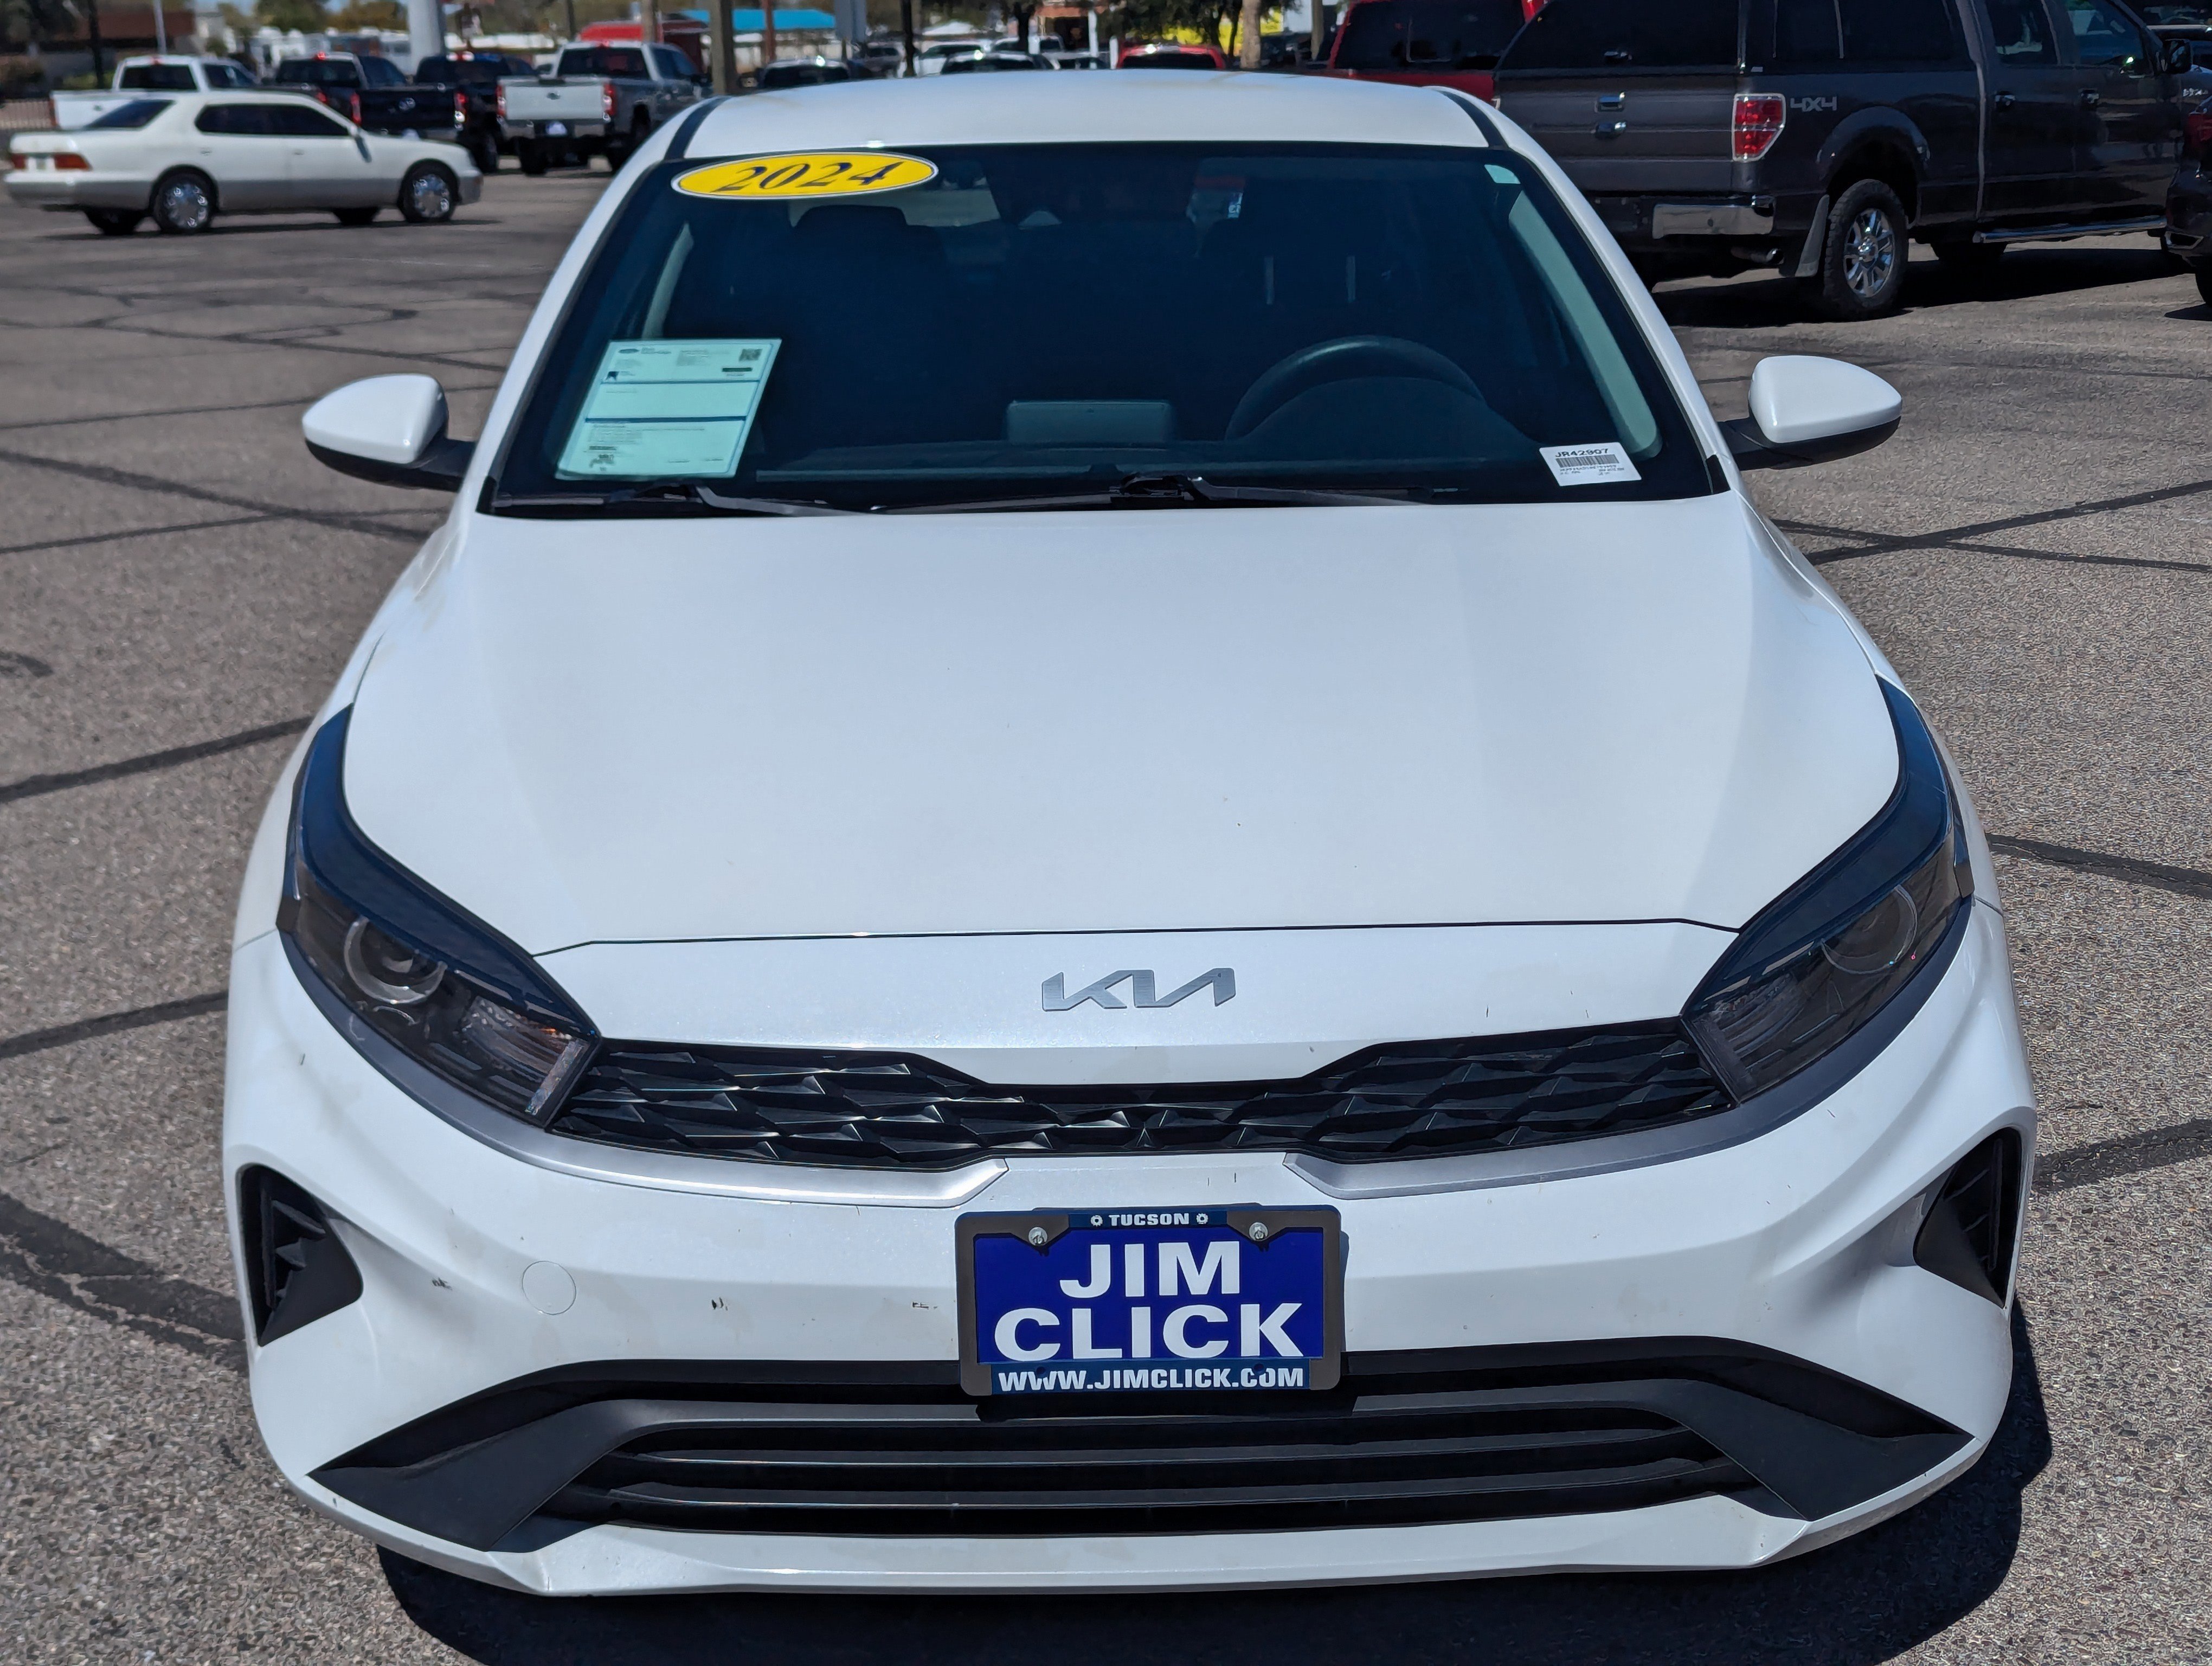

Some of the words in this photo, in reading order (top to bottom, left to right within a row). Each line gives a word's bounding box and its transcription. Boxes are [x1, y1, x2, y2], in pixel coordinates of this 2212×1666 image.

[1790, 97, 1837, 112] 4X4
[710, 161, 905, 194] 2024
[1042, 967, 1236, 1011] KIA
[1109, 1213, 1190, 1226] TUCSON
[1059, 1240, 1240, 1299] JIM
[994, 1302, 1304, 1362] CLICK
[999, 1367, 1303, 1392] WWW.JIMCLICK.COM
